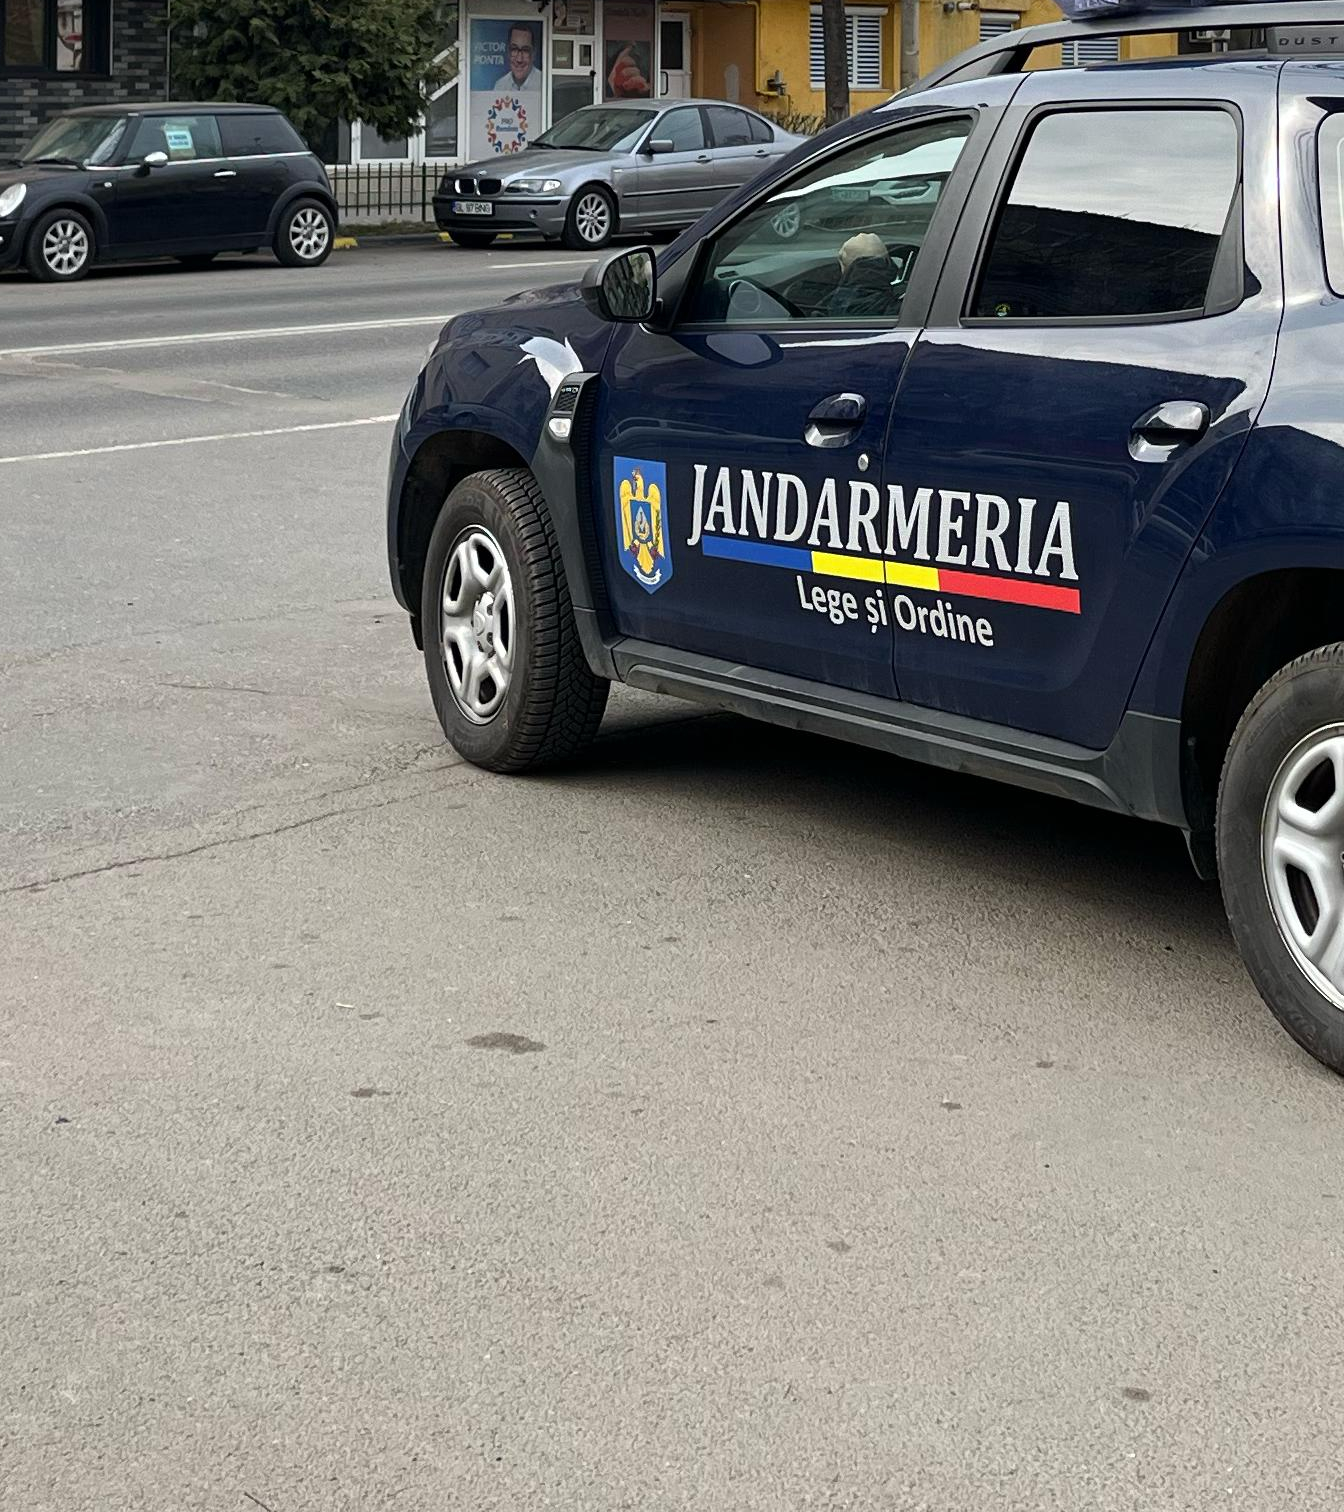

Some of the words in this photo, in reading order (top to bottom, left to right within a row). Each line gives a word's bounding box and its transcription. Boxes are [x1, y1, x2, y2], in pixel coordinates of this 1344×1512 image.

[687, 464, 1079, 580] JANDARMERIA
[797, 575, 858, 626] Lege
[867, 591, 888, 633] și
[894, 595, 994, 647] Ordine
